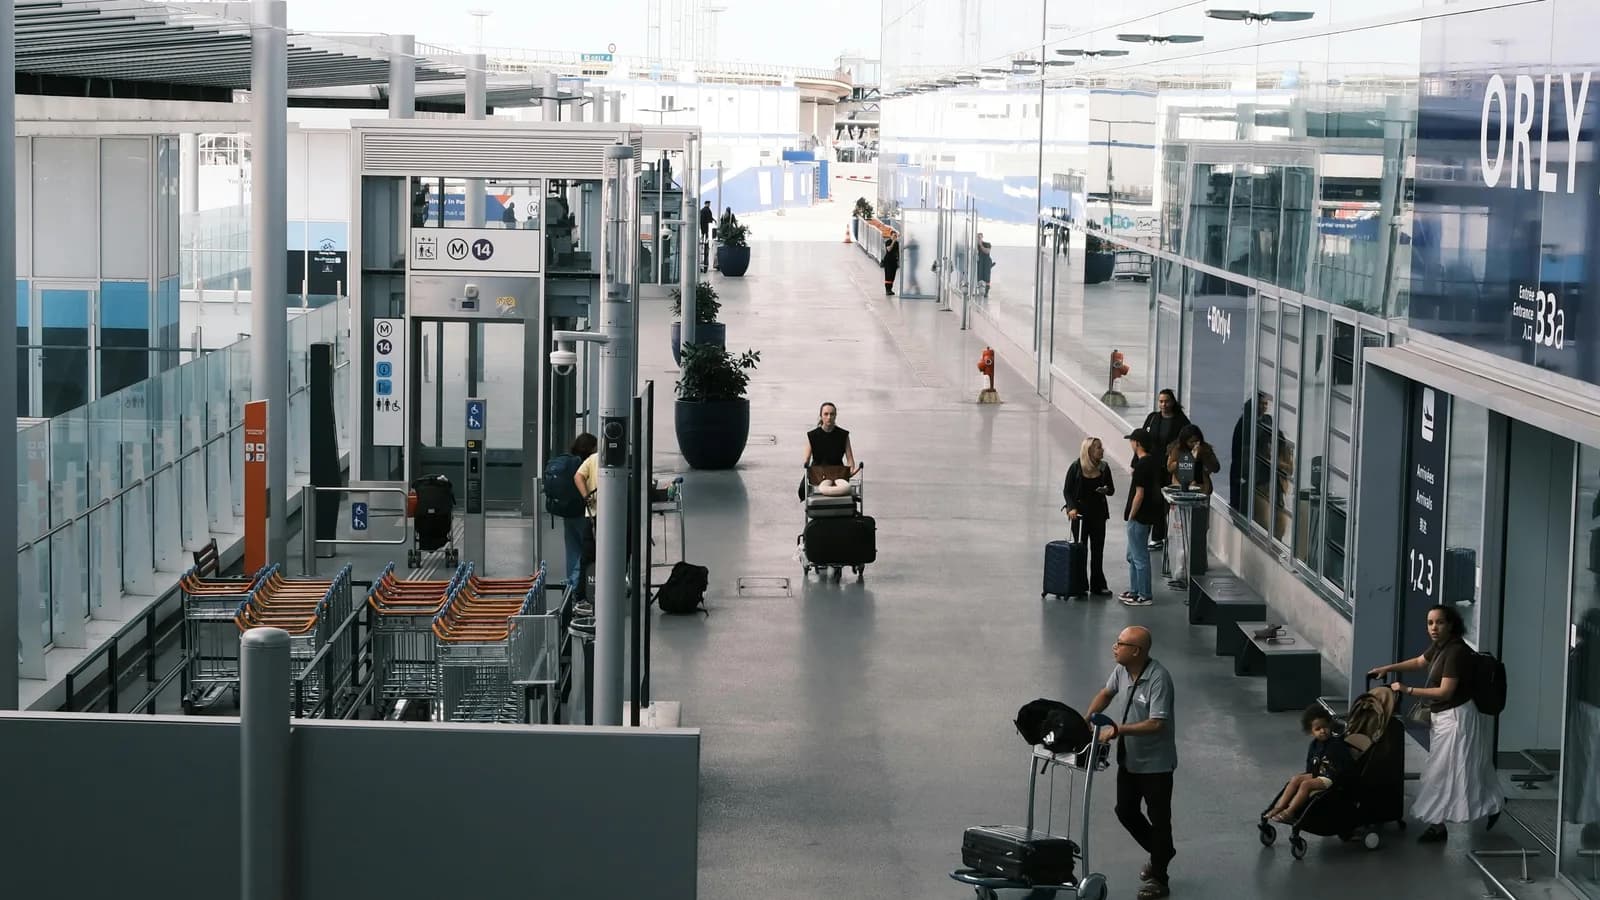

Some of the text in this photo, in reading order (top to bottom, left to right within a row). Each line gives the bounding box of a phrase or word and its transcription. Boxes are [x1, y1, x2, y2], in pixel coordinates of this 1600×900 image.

[1481, 72, 1591, 193] ORLY
[474, 243, 491, 256] 14
[1519, 285, 1535, 302] Entrée
[1513, 301, 1534, 320] Entrance
[1535, 290, 1565, 350] 33a
[1522, 323, 1533, 341] 入口
[1416, 463, 1435, 485] Arrivées
[1415, 489, 1433, 511] Arrivals
